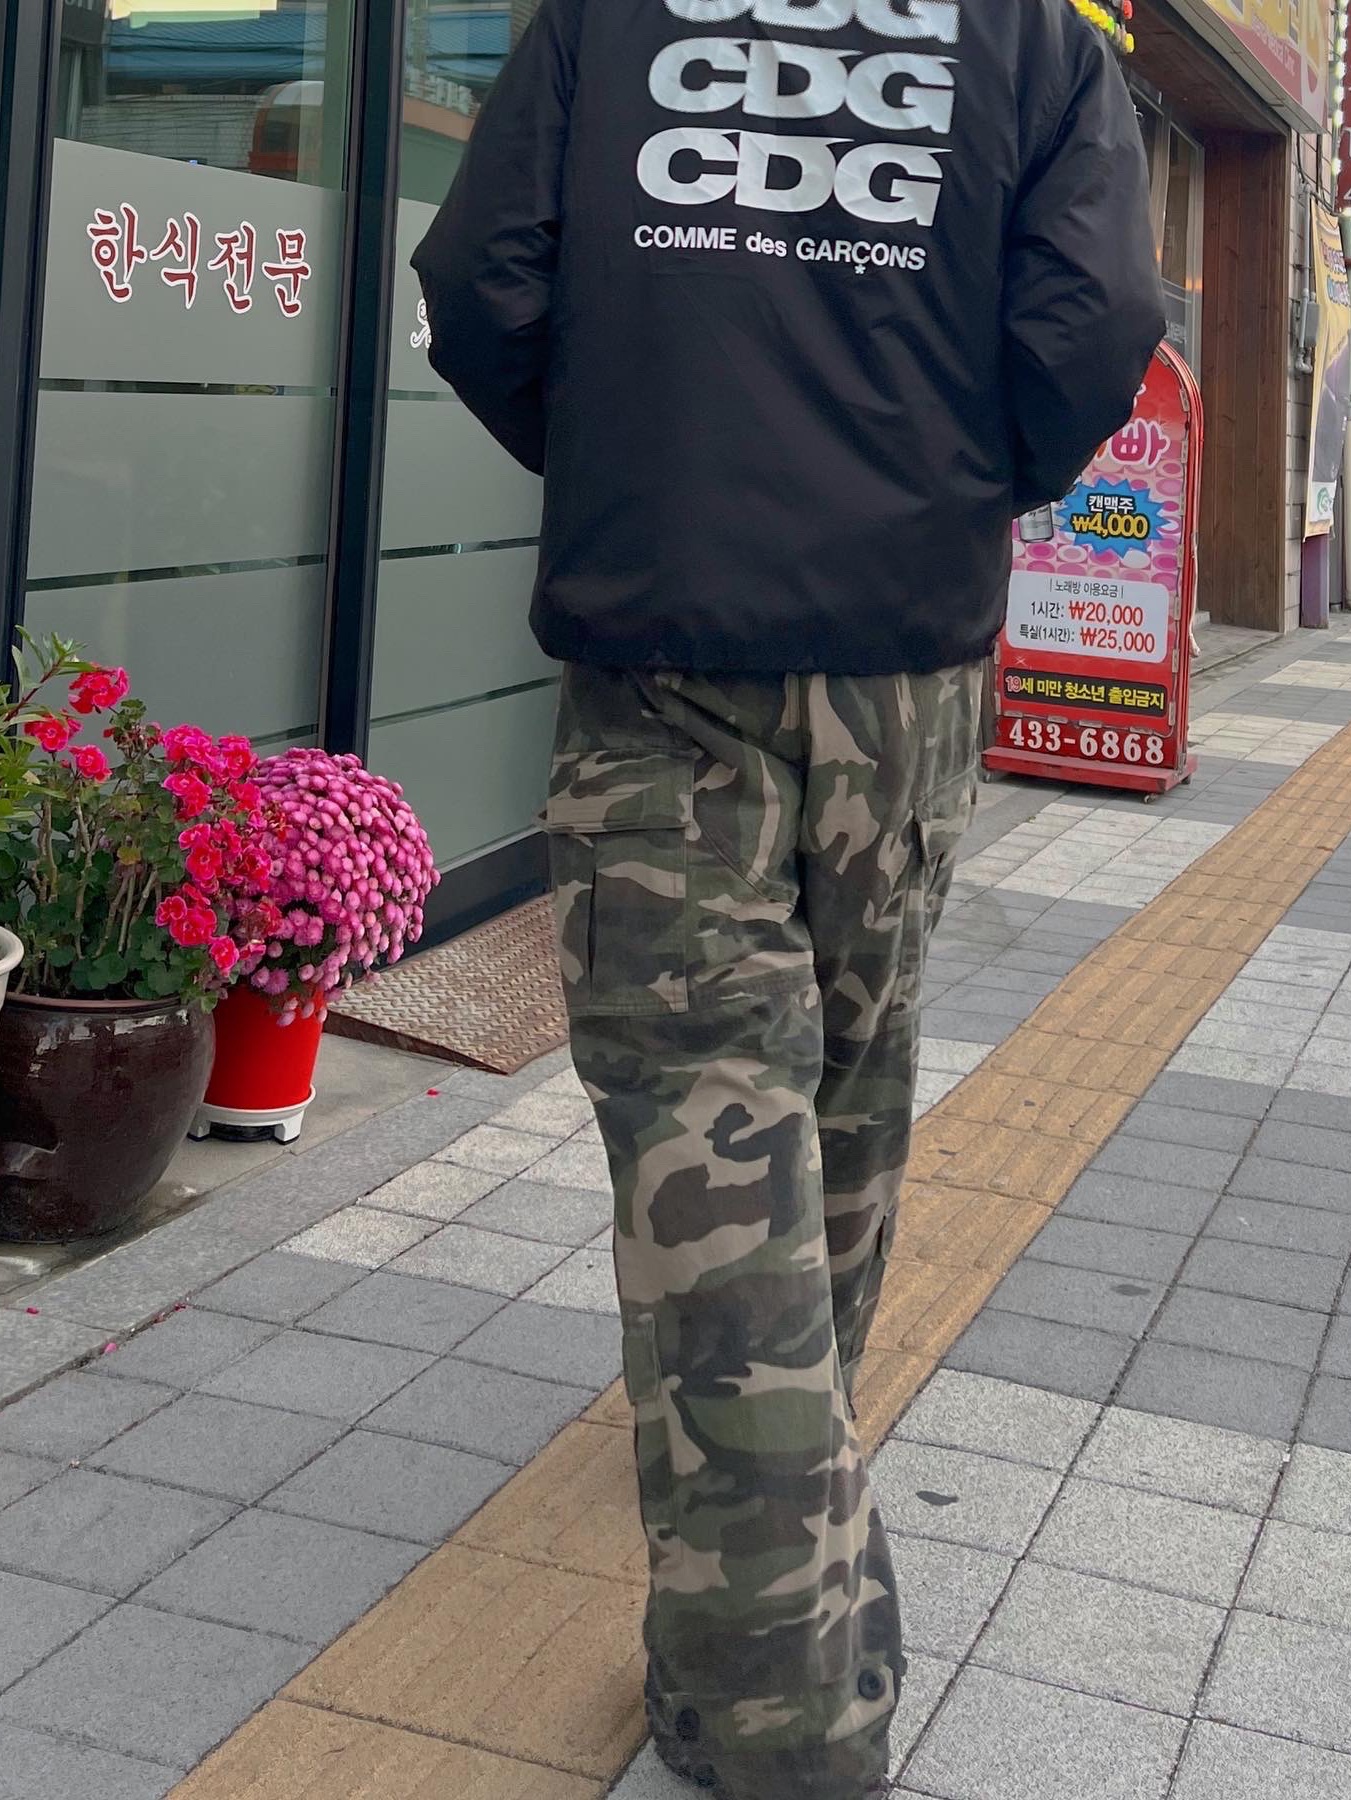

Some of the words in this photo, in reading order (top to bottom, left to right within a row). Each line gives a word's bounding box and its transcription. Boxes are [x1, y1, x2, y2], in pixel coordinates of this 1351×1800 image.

[648, 37, 961, 134] CDG
[636, 126, 953, 226] CDG
[87, 202, 311, 318] 한식전문
[634, 224, 738, 250] COMME
[745, 232, 787, 257] des
[795, 237, 926, 275] GARÇONS
[1088, 494, 1135, 514] 캔맥주
[1071, 513, 1149, 539] ₩4,000
[1055, 580, 1082, 594] 노래방
[1083, 583, 1118, 598] 이용요금
[1031, 601, 1065, 620] 1시간:
[1069, 600, 1144, 627] ₩20,000
[1019, 624, 1075, 643] 특실(1시간):
[1080, 627, 1155, 654] ₩25,000
[1005, 675, 1034, 695] 19세
[1036, 679, 1062, 698] 미만
[1064, 683, 1105, 703] 청소년
[1107, 689, 1165, 710] 출입금지
[1009, 718, 1164, 765] 433-6868
